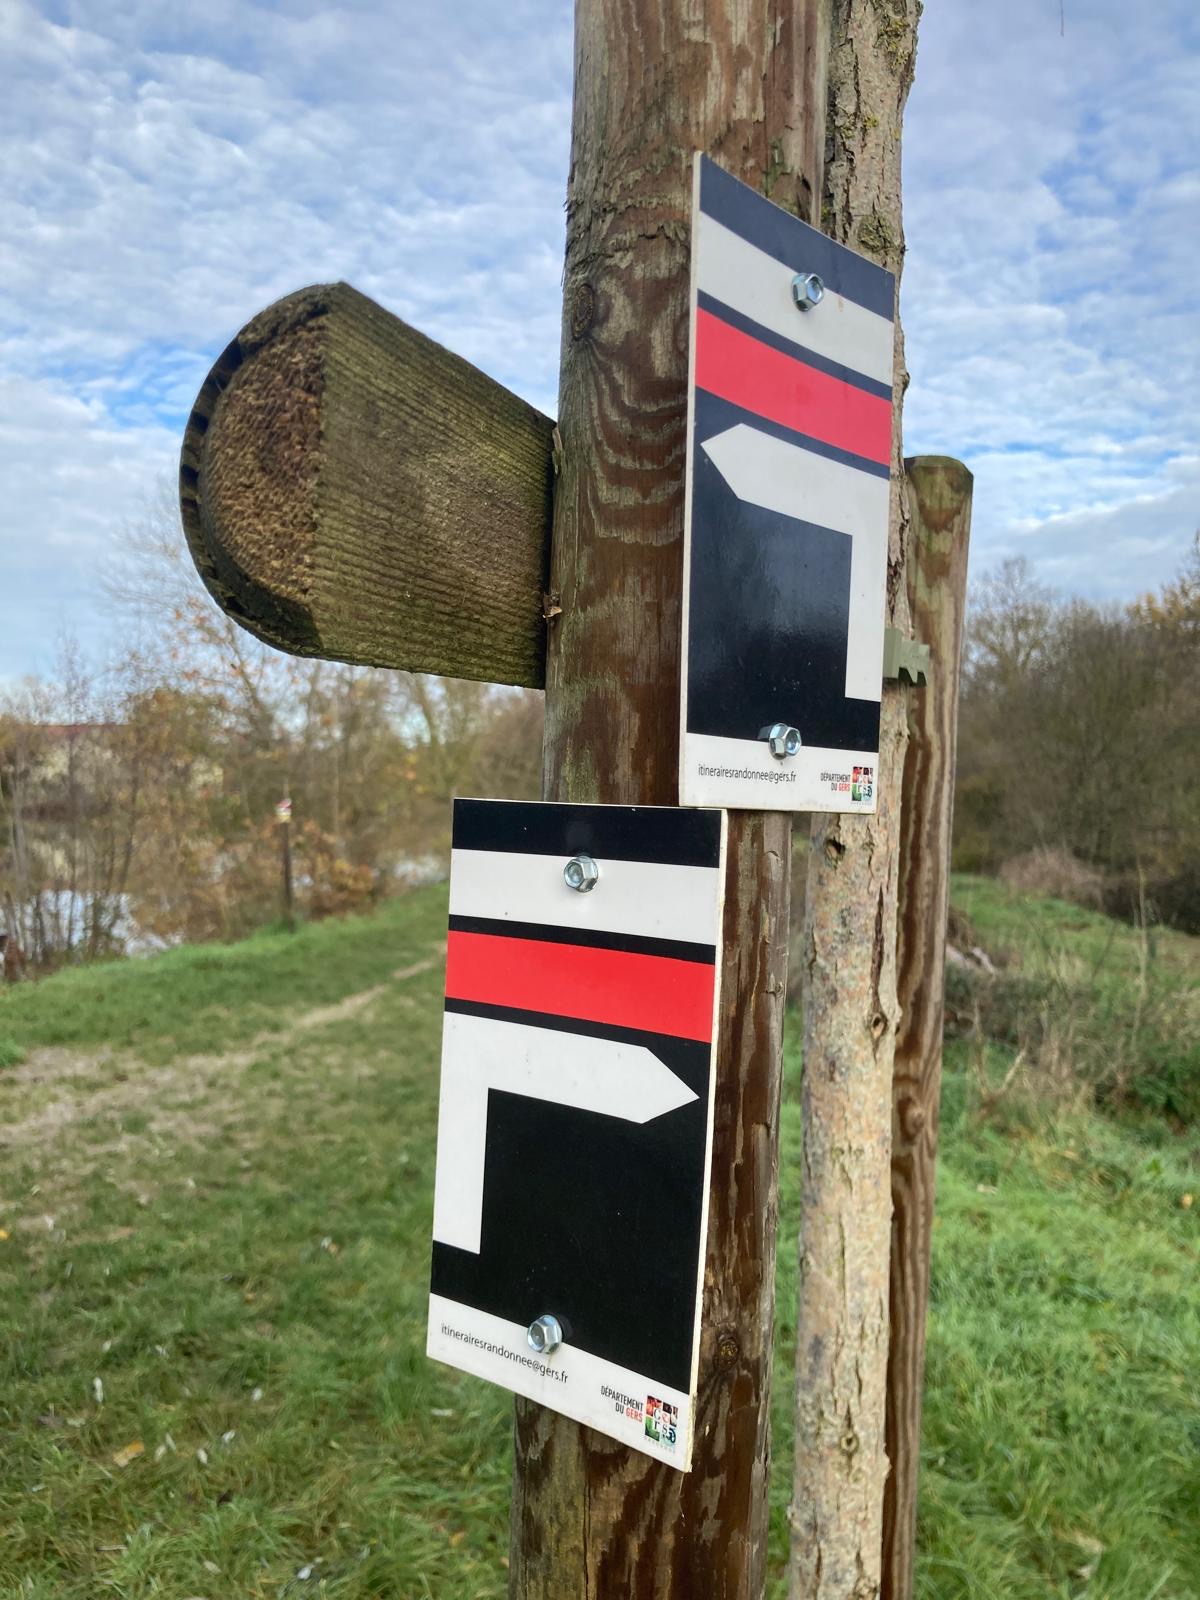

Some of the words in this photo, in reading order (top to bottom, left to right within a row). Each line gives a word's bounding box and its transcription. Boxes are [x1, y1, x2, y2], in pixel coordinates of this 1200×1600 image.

[698, 764, 796, 784] itinerairesrandonnee@gers.fr
[441, 1324, 568, 1383] itinerairesrandonnee@gers.fr
[601, 1385, 644, 1411] DÉPARTEMENT
[615, 1402, 624, 1414] DU
[626, 1407, 643, 1423] GERS
